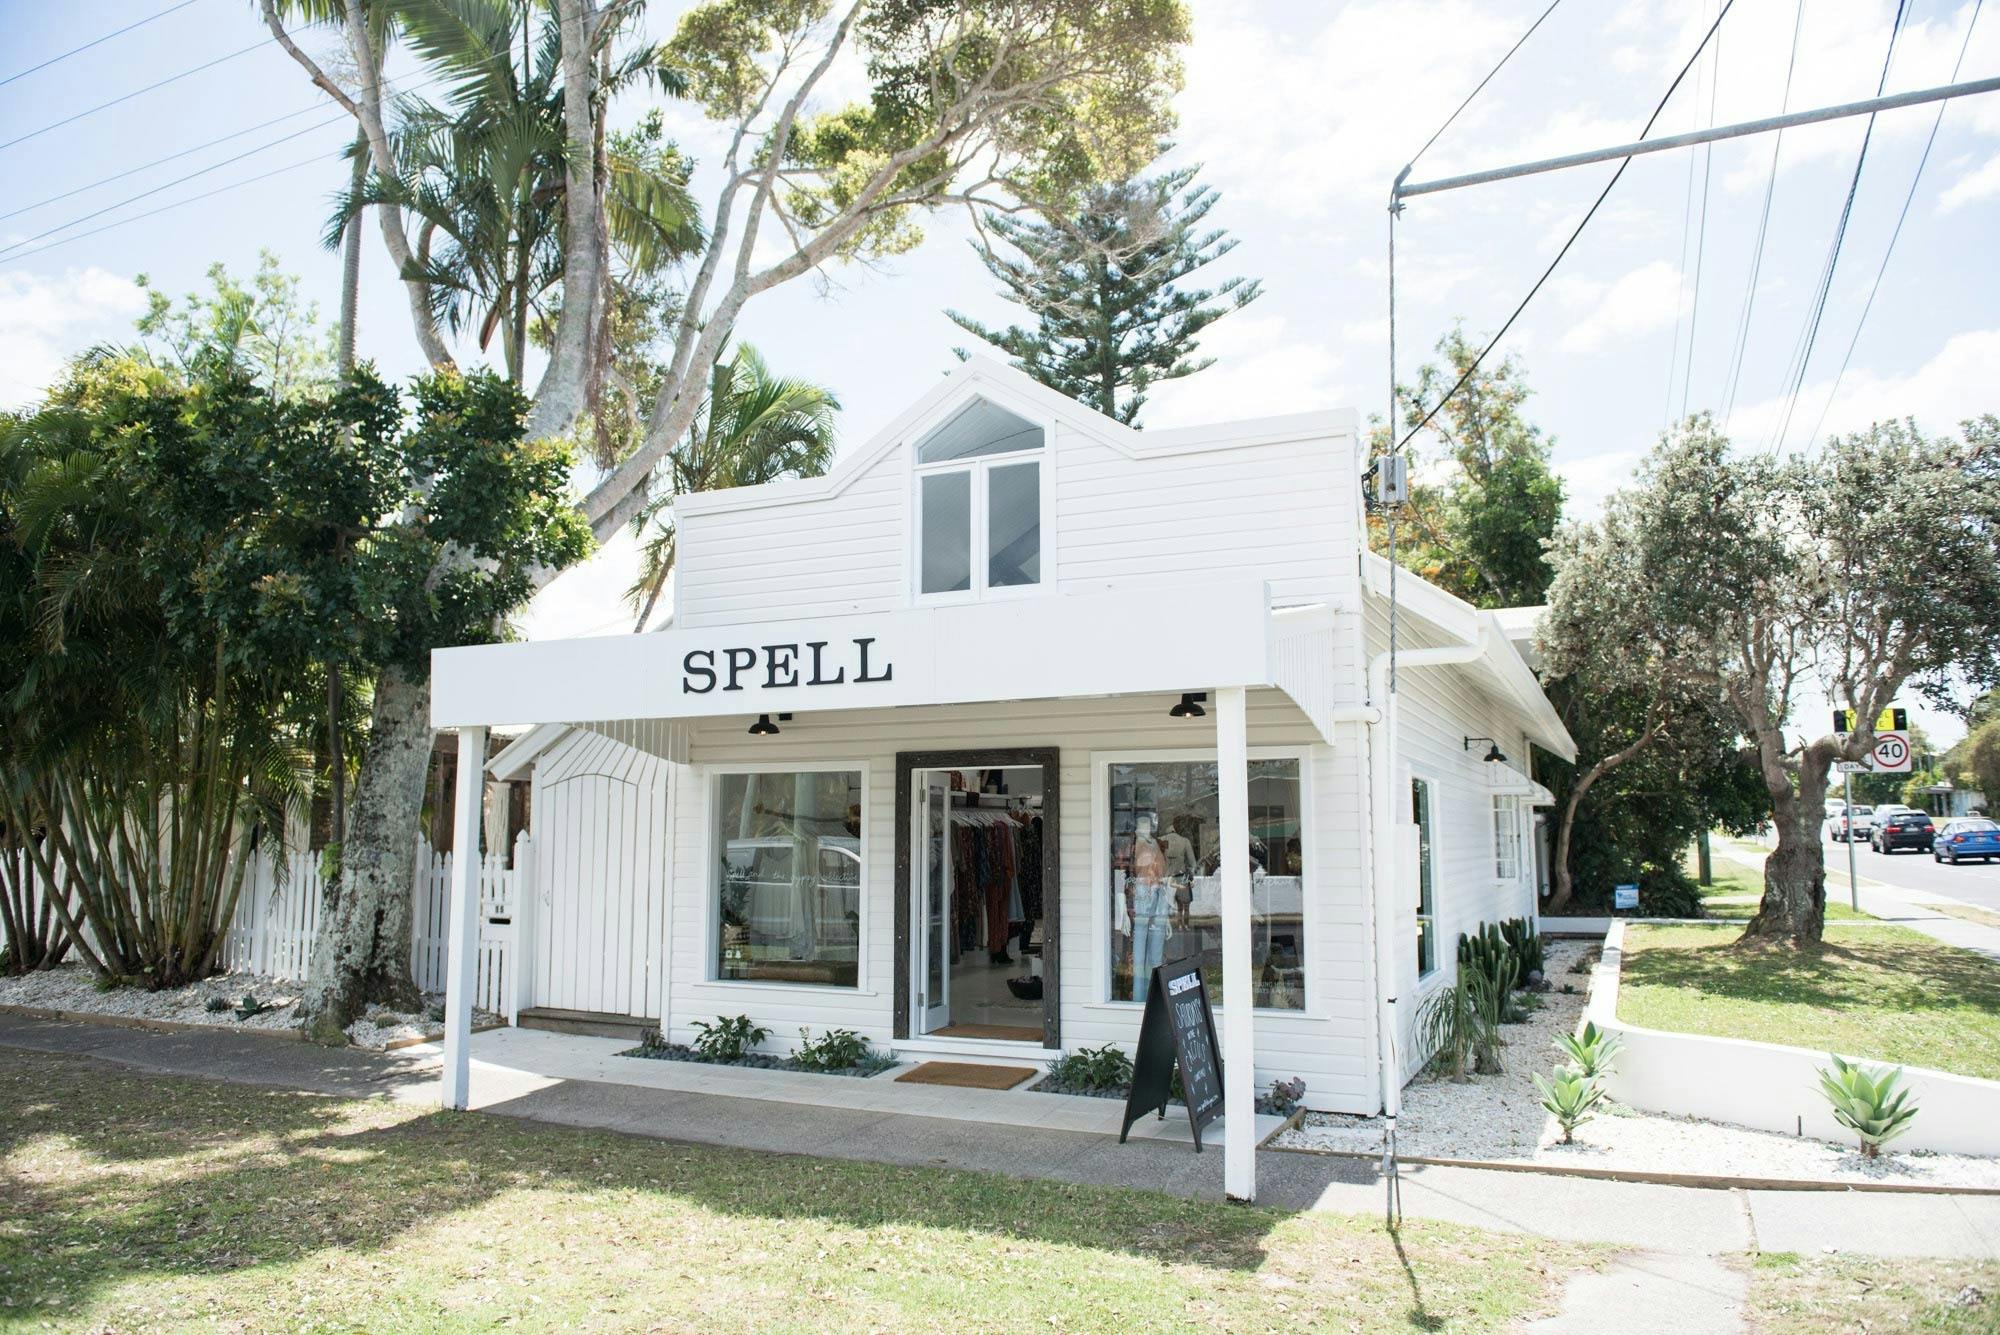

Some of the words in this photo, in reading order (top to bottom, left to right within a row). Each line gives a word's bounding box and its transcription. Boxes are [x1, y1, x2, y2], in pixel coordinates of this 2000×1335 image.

[683, 637, 893, 694] SPELL
[1878, 743, 1903, 758] 40
[495, 905, 505, 914] 15
